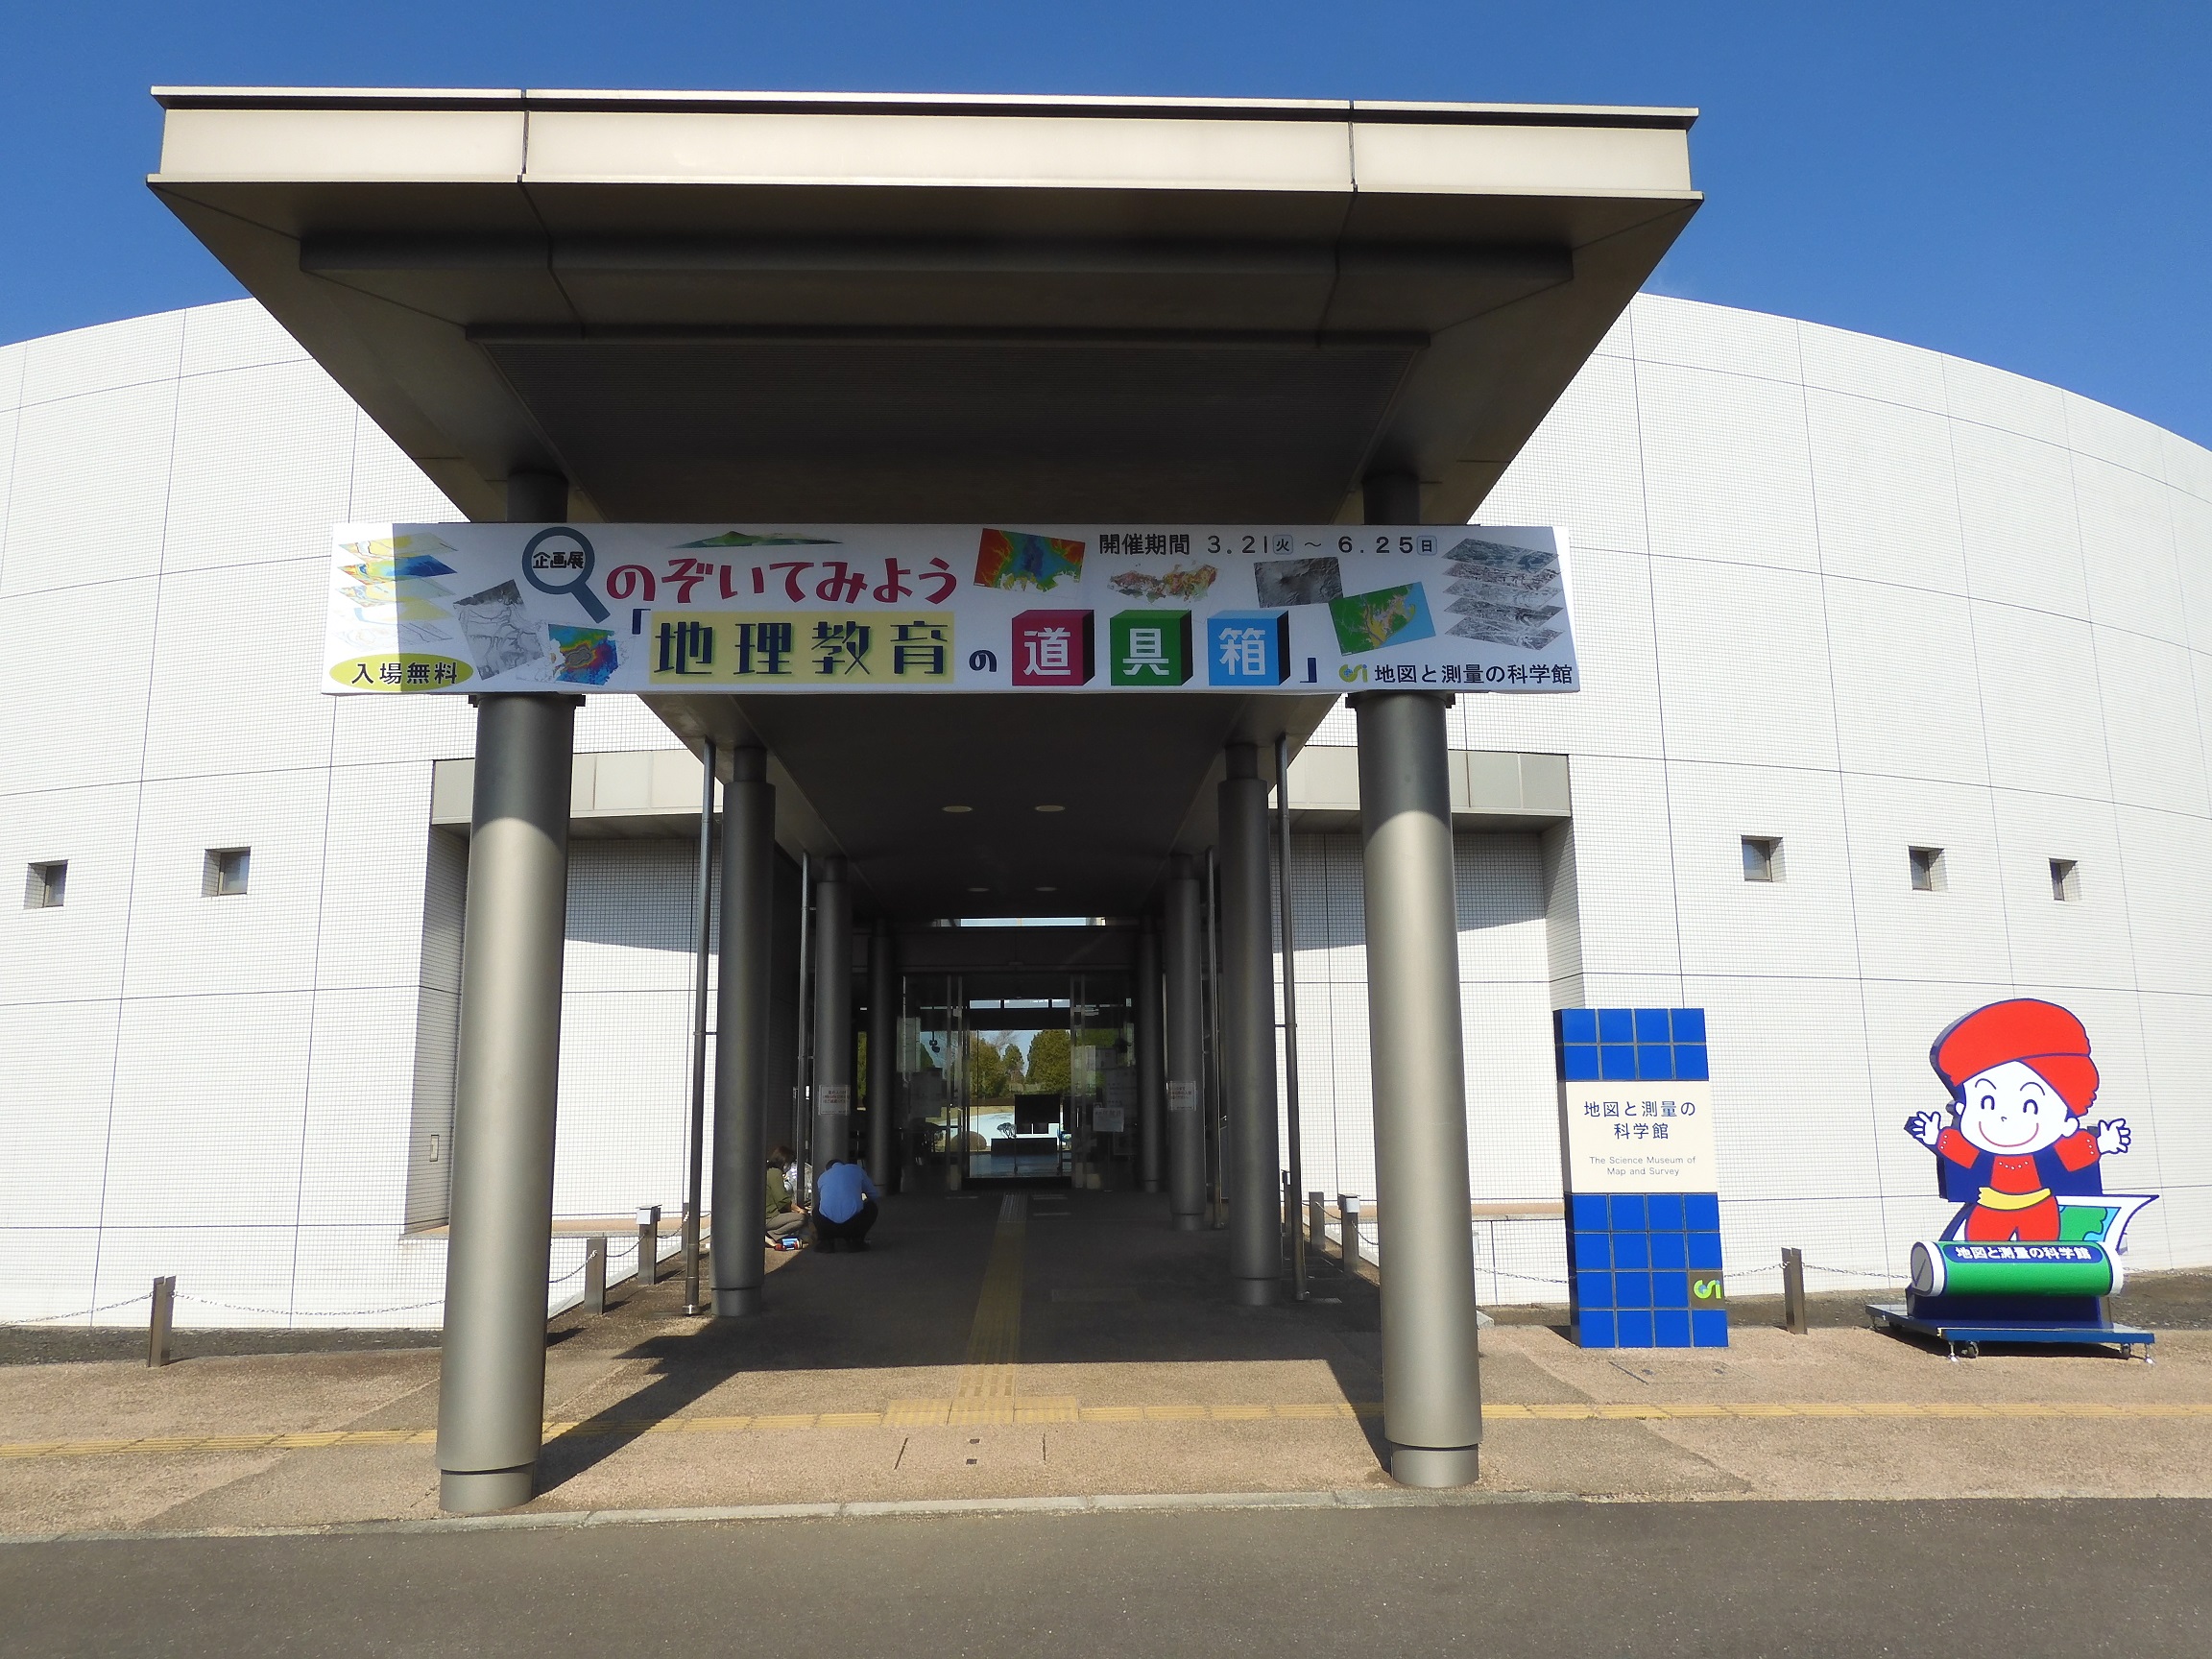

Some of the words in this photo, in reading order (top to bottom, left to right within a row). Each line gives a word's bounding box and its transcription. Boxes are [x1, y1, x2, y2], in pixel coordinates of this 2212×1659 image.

[1099, 534, 1190, 555] 開催期間
[533, 551, 585, 569] 企画展
[606, 557, 957, 604] のぞいてみよう
[351, 661, 458, 685] 入場無料
[1374, 663, 1573, 685] 地図と測量の科学館
[1583, 1100, 1696, 1118] 地図と測量の
[1614, 1122, 1669, 1140] 科学館
[1589, 1156, 1606, 1165] The
[1609, 1156, 1644, 1165] Science
[1647, 1156, 1684, 1165] Museum
[1687, 1155, 1696, 1165] of
[1607, 1167, 1626, 1176] Map
[1629, 1166, 1647, 1175] and
[1649, 1166, 1680, 1176] Survey
[1955, 1244, 2092, 1261] 地図と測量の科学館
